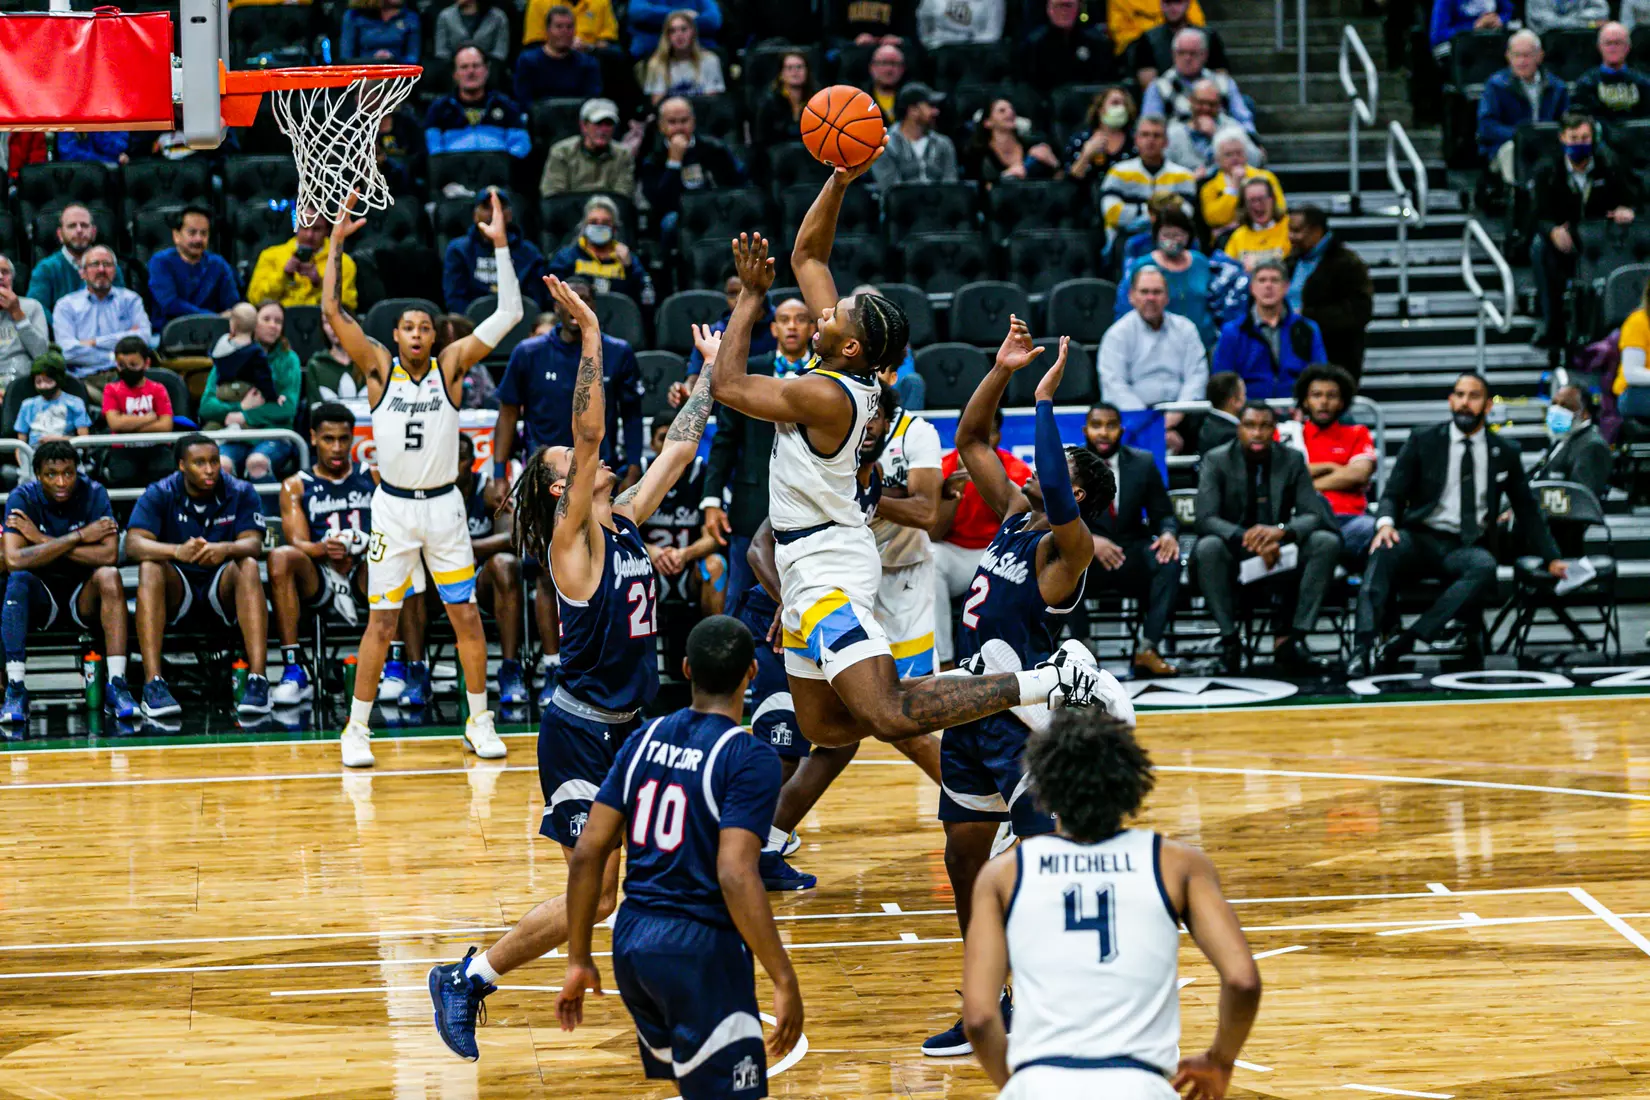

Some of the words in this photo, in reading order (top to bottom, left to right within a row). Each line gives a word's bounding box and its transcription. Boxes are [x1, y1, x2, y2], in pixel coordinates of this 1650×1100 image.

[404, 421, 424, 451] 5
[308, 495, 348, 522] Jackson
[1540, 488, 1570, 515] MU
[326, 509, 361, 538] 11
[649, 528, 689, 549] 21
[992, 552, 1029, 585] State
[962, 573, 991, 631] 2
[645, 740, 704, 772] TAYLOR
[631, 778, 688, 853] 10
[1039, 852, 1137, 875] MITCHELL
[1062, 881, 1120, 964] 4
